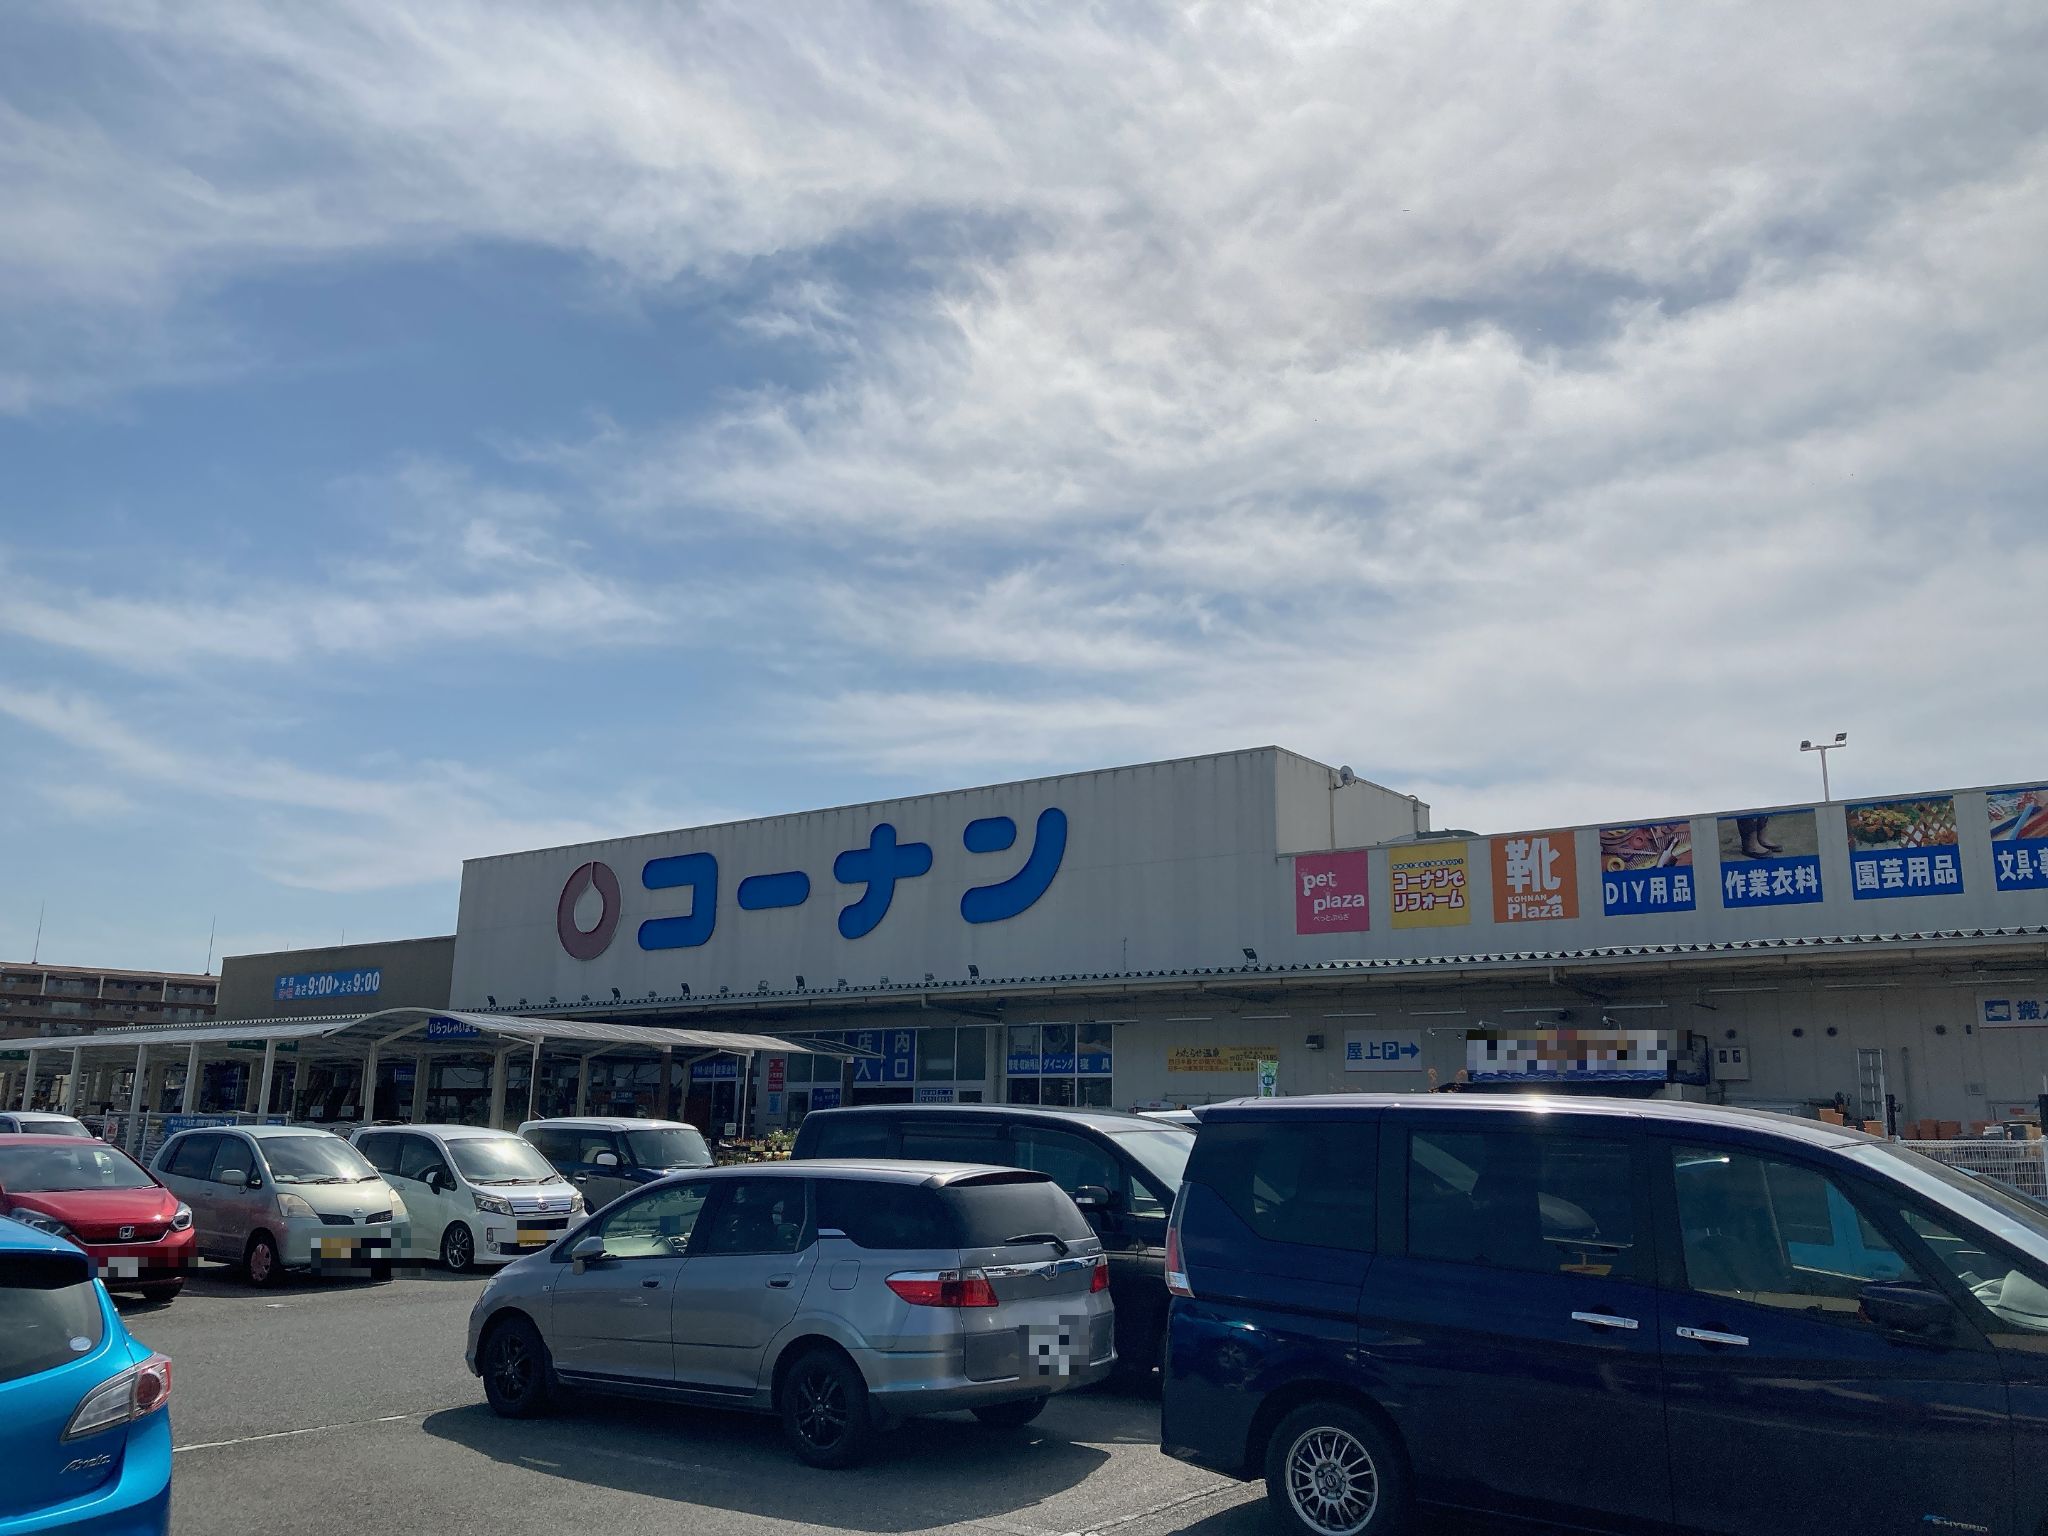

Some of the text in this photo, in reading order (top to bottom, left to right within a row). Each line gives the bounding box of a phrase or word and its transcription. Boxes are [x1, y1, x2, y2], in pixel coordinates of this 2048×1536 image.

[1504, 837, 1562, 893] 靴
[1854, 855, 1958, 891] 園芸用品
[637, 807, 1068, 951] コーナン
[1303, 871, 1338, 896] pet
[1393, 868, 1466, 891] コーナンで
[1605, 875, 1692, 905] DIY用品
[1725, 864, 1818, 899] 作業衣料
[1313, 894, 1365, 914] plaza
[1394, 889, 1465, 913] リフォーム
[1507, 894, 1547, 903] KOHNAN
[1508, 903, 1564, 920] Plaza
[2016, 1000, 2048, 1020] 搬
[1043, 1058, 1074, 1070] ダイニング
